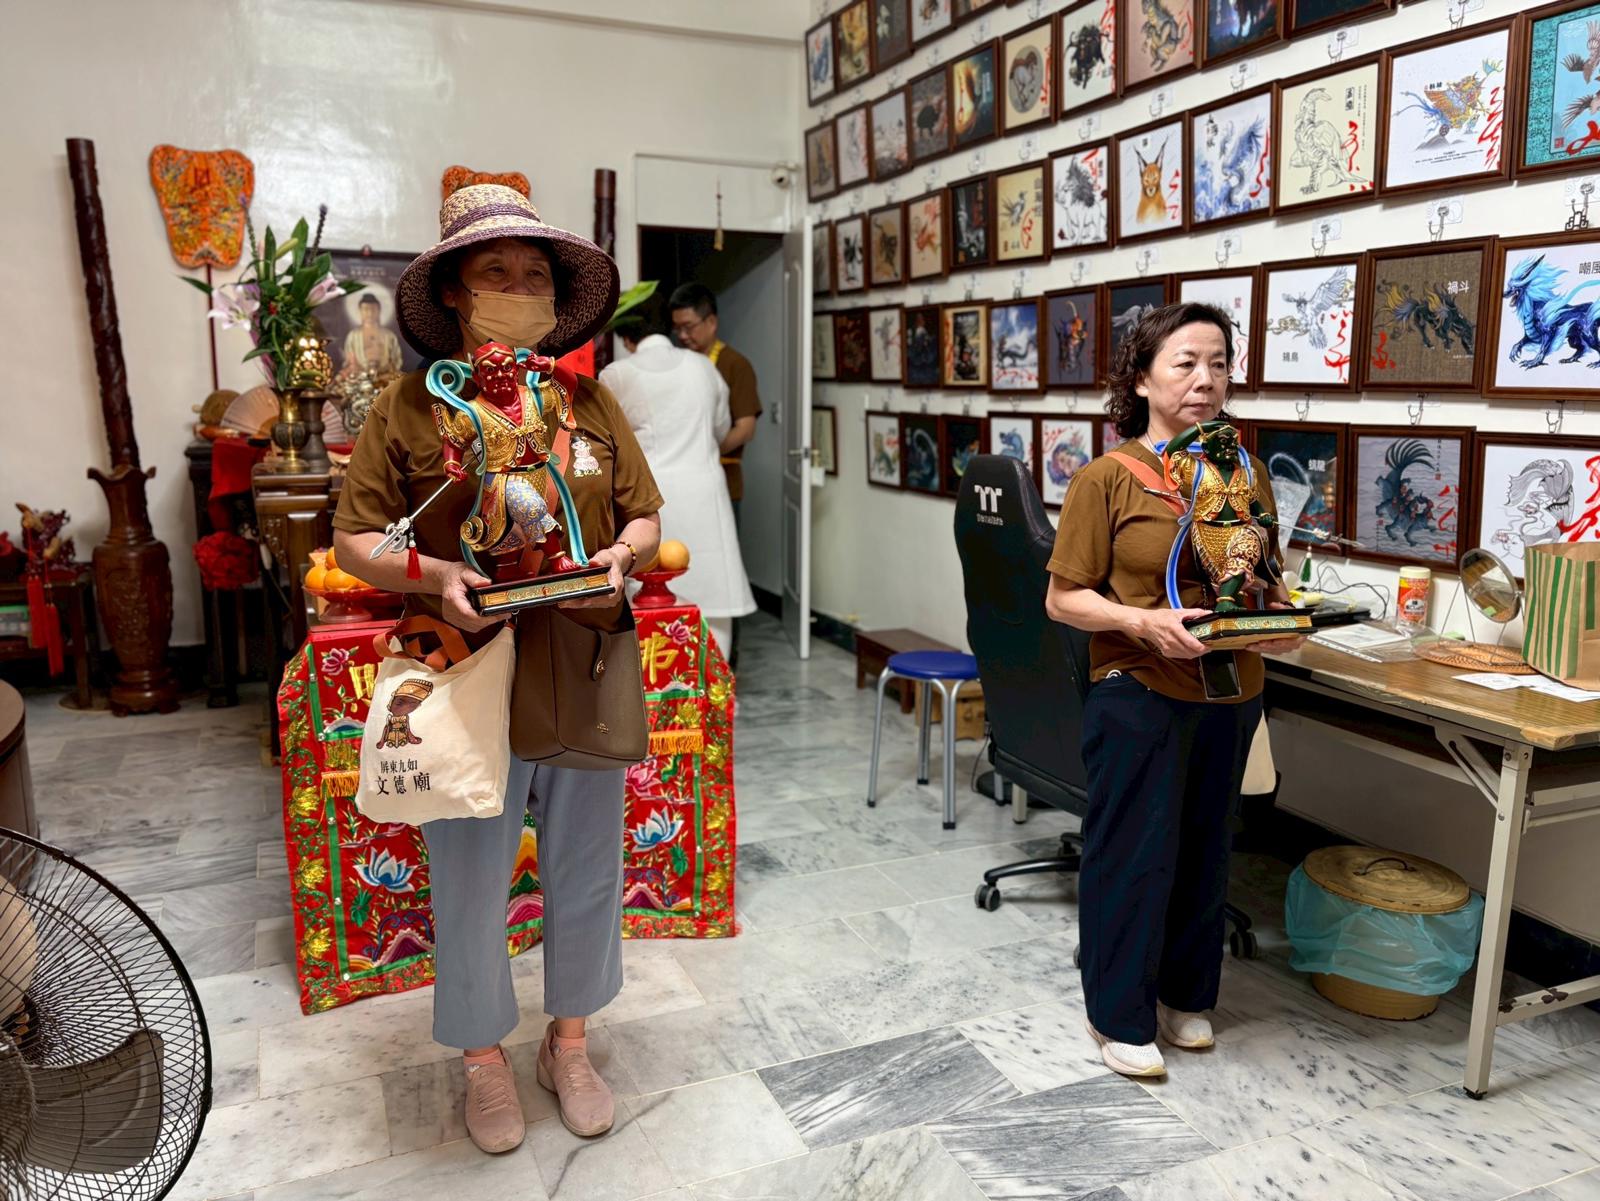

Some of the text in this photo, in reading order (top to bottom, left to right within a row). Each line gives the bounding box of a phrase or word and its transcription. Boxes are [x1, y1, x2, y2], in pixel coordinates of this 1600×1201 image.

[381, 758, 417, 773] 屏東九如
[375, 772, 431, 795] 文德廟
